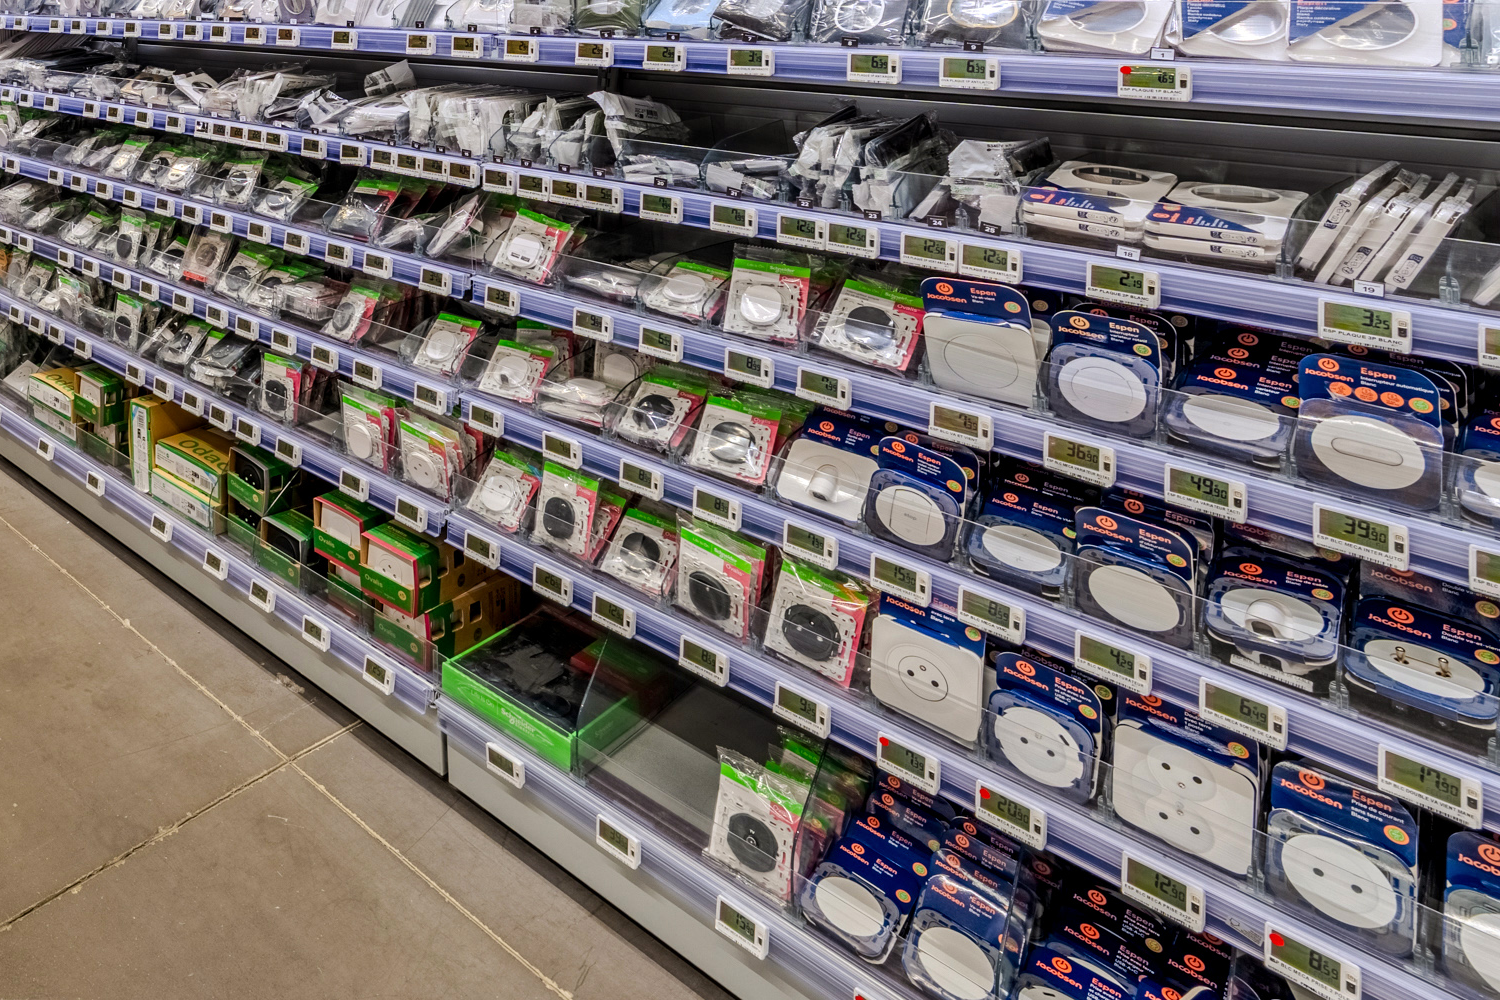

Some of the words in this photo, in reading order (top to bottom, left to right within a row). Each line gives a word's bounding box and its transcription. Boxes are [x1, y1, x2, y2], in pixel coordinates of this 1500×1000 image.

[970, 287, 997, 297] Espen
[897, 303, 918, 313] Ovalis
[1109, 322, 1139, 334] Espen
[1360, 367, 1396, 380] Espen
[1258, 376, 1292, 389] Espen
[1360, 376, 1394, 387] Interrupteur
[1395, 382, 1434, 394] automatique
[318, 534, 335, 549] Ovalis
[1139, 528, 1172, 545] Espen
[1344, 541, 1363, 550] MECA
[1364, 547, 1383, 556] INTER
[1384, 553, 1402, 562] AUTO
[725, 563, 744, 576] Ovalis
[1286, 570, 1322, 583] Espen
[364, 572, 383, 588] Ovalis
[1442, 623, 1482, 641] Espen
[1054, 677, 1085, 695] Espen
[501, 708, 538, 734] Schneider
[1352, 789, 1392, 813] Espen
[1351, 799, 1367, 810] Prise
[1367, 804, 1376, 812] de
[1377, 808, 1404, 824] courant
[1351, 811, 1369, 823] Blanc
